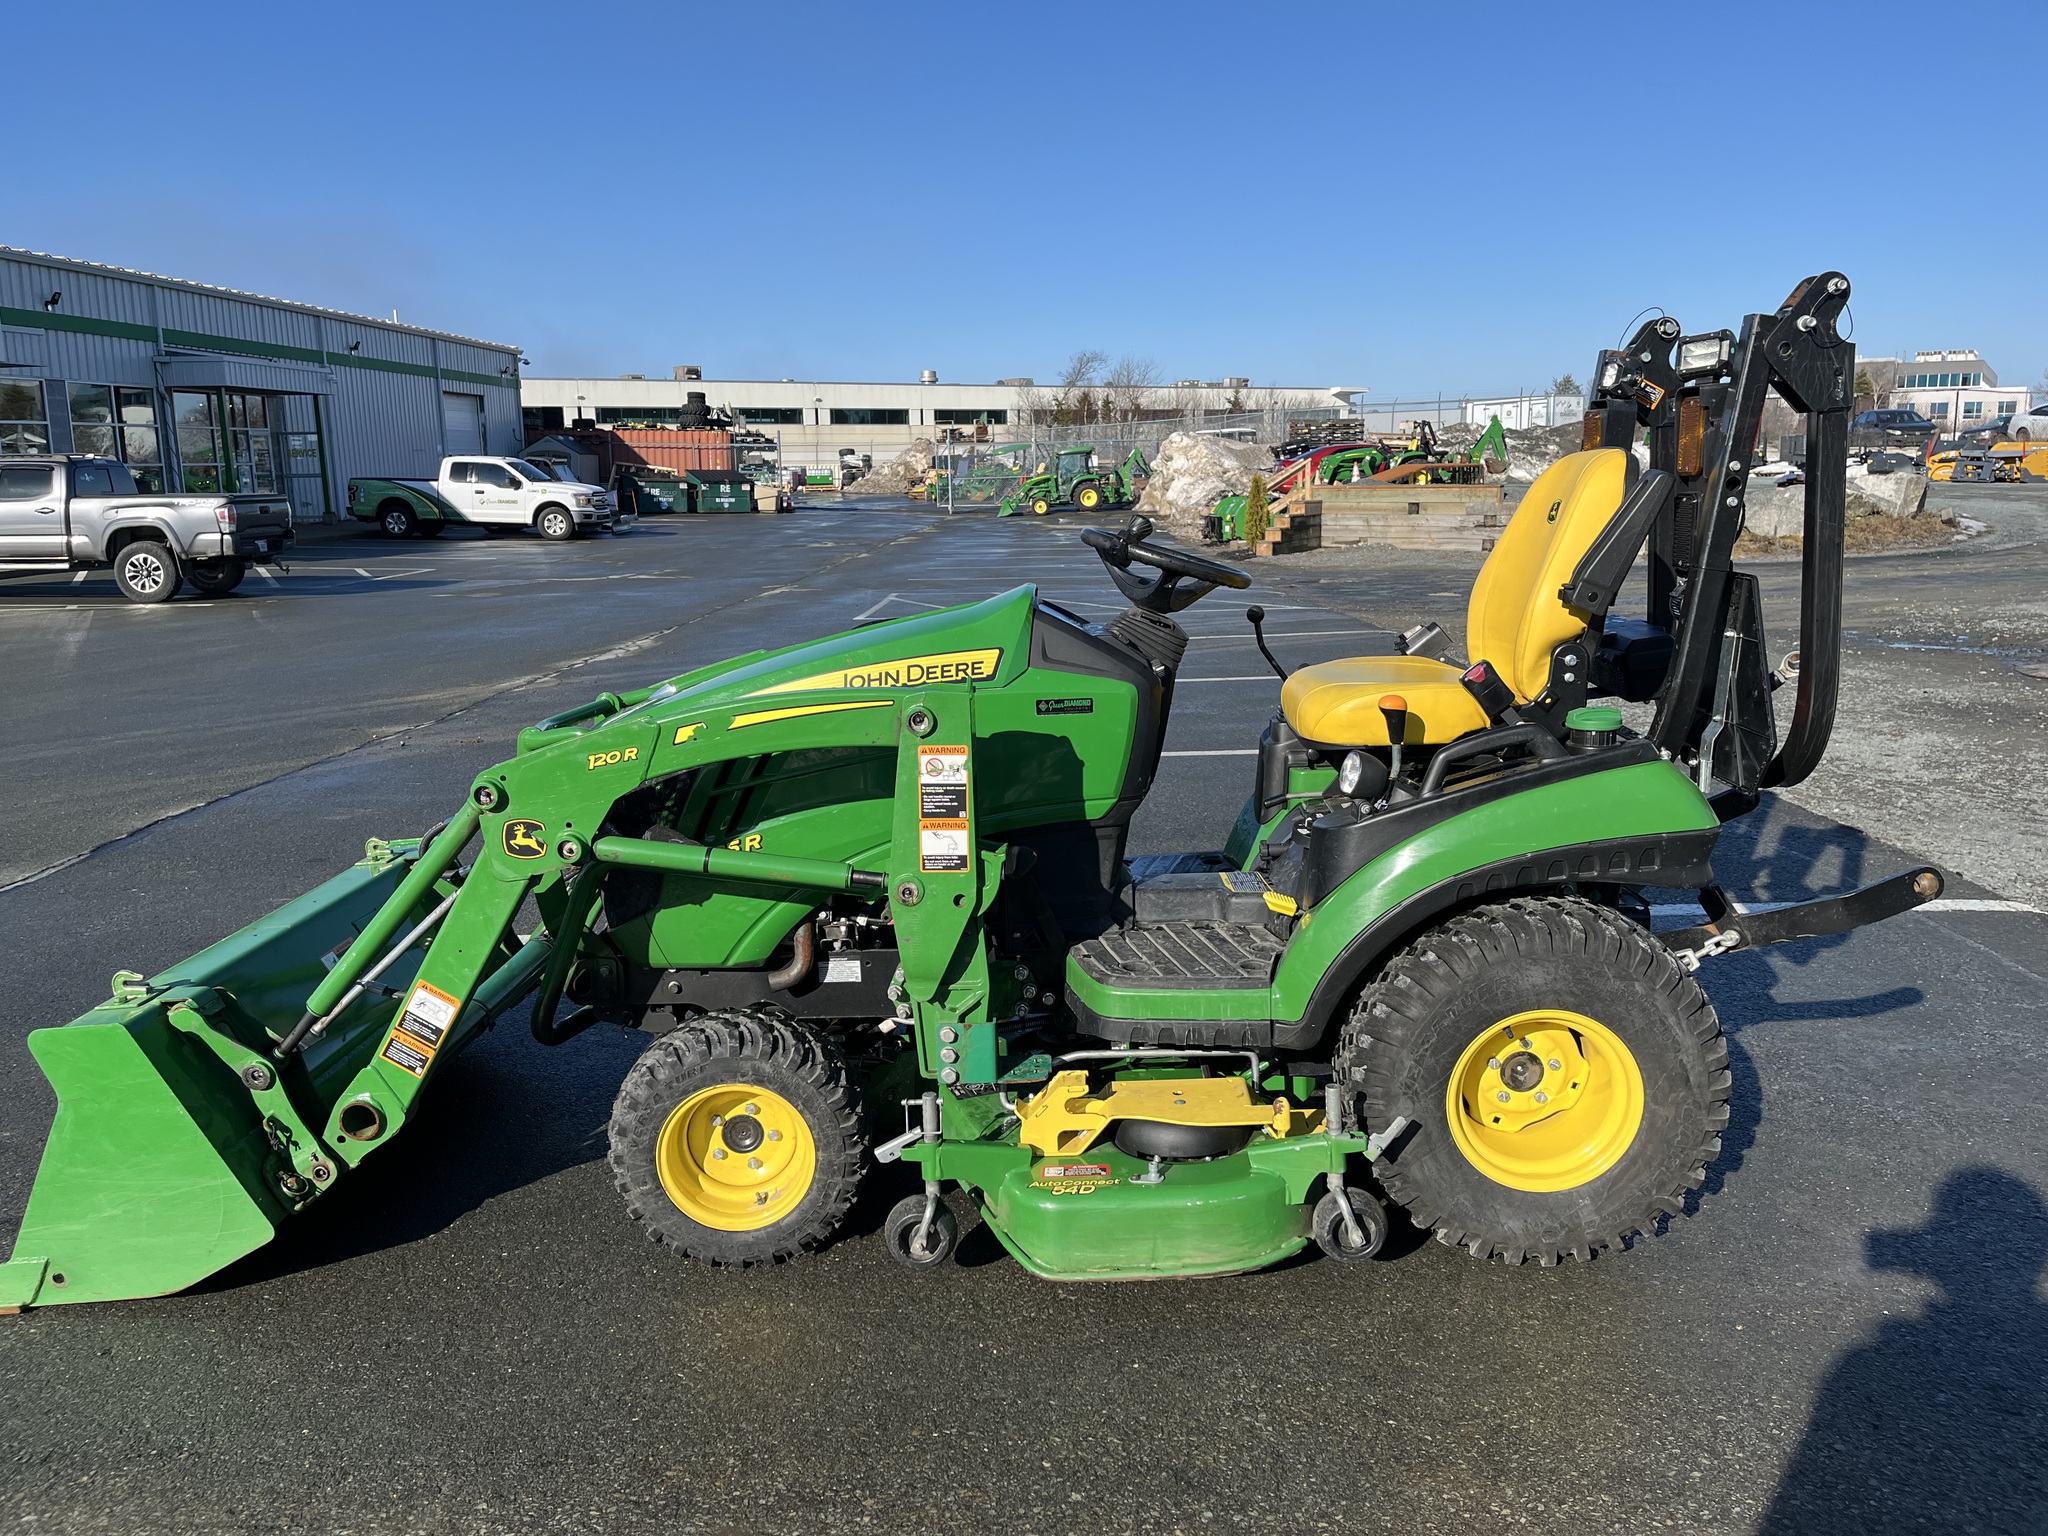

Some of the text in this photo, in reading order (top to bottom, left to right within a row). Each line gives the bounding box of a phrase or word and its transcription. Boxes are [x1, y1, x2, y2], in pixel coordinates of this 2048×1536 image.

[288, 449, 317, 458] SERVICE
[651, 488, 660, 496] RE
[720, 484, 731, 493] RE
[843, 660, 985, 687] JOHN DEERE
[428, 986, 456, 1005] WARNING
[402, 1037, 430, 1055] WARNING
[1027, 1178, 1121, 1188] AutoConnect
[1051, 1185, 1097, 1196] 54D
